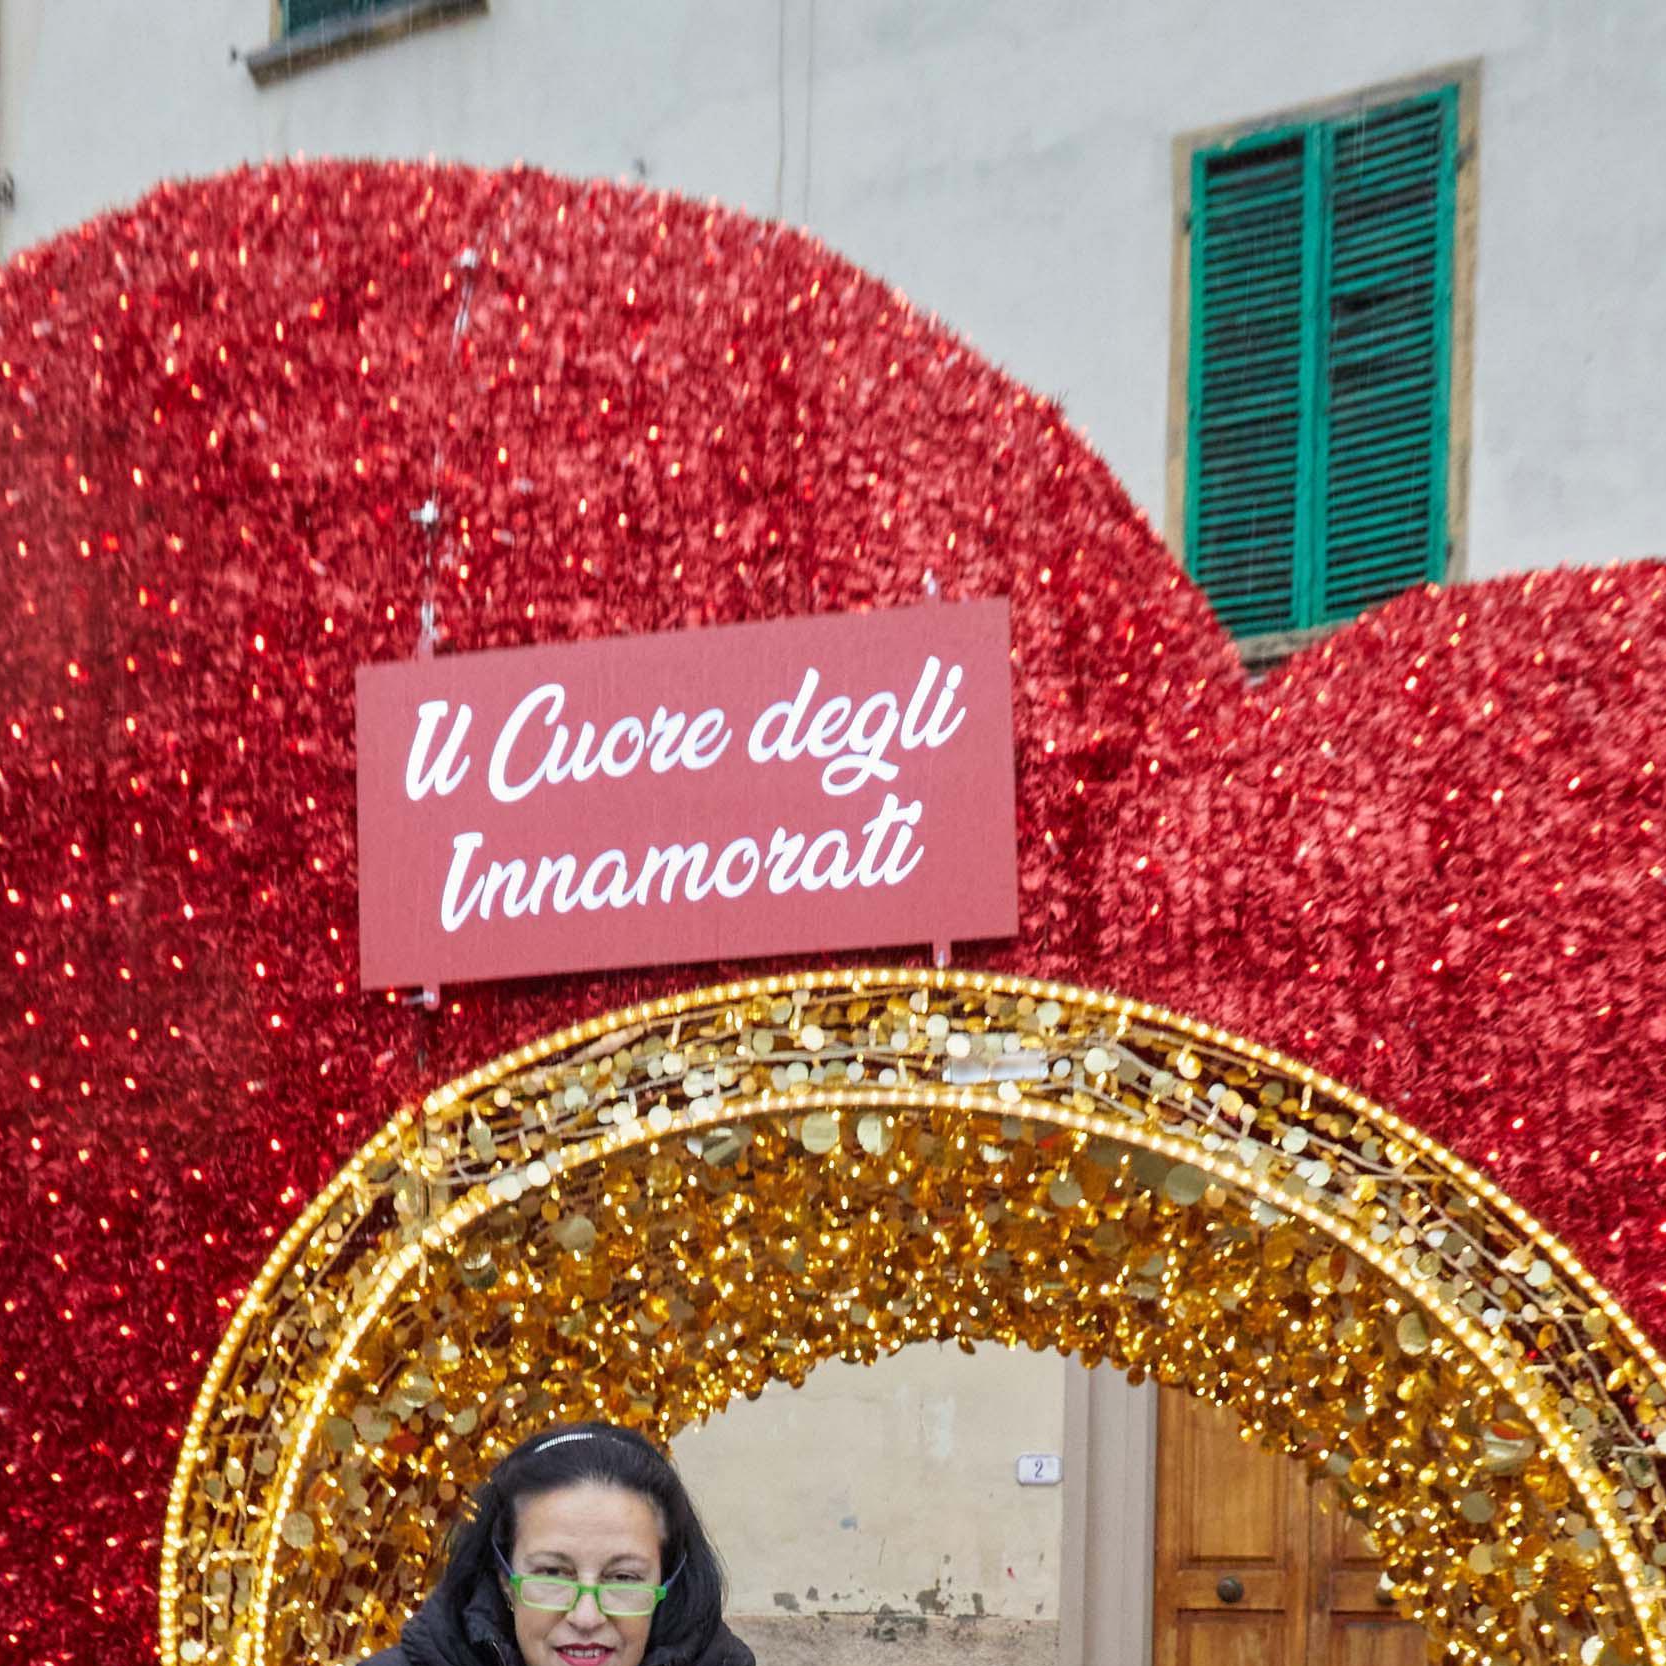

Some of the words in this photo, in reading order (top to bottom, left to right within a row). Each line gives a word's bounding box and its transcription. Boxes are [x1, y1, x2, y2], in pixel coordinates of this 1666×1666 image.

[406, 700, 471, 801] Il
[488, 684, 731, 802] Cuore
[747, 656, 966, 795] degli
[440, 793, 924, 932] Innamorati
[1034, 1460, 1044, 1479] 2
